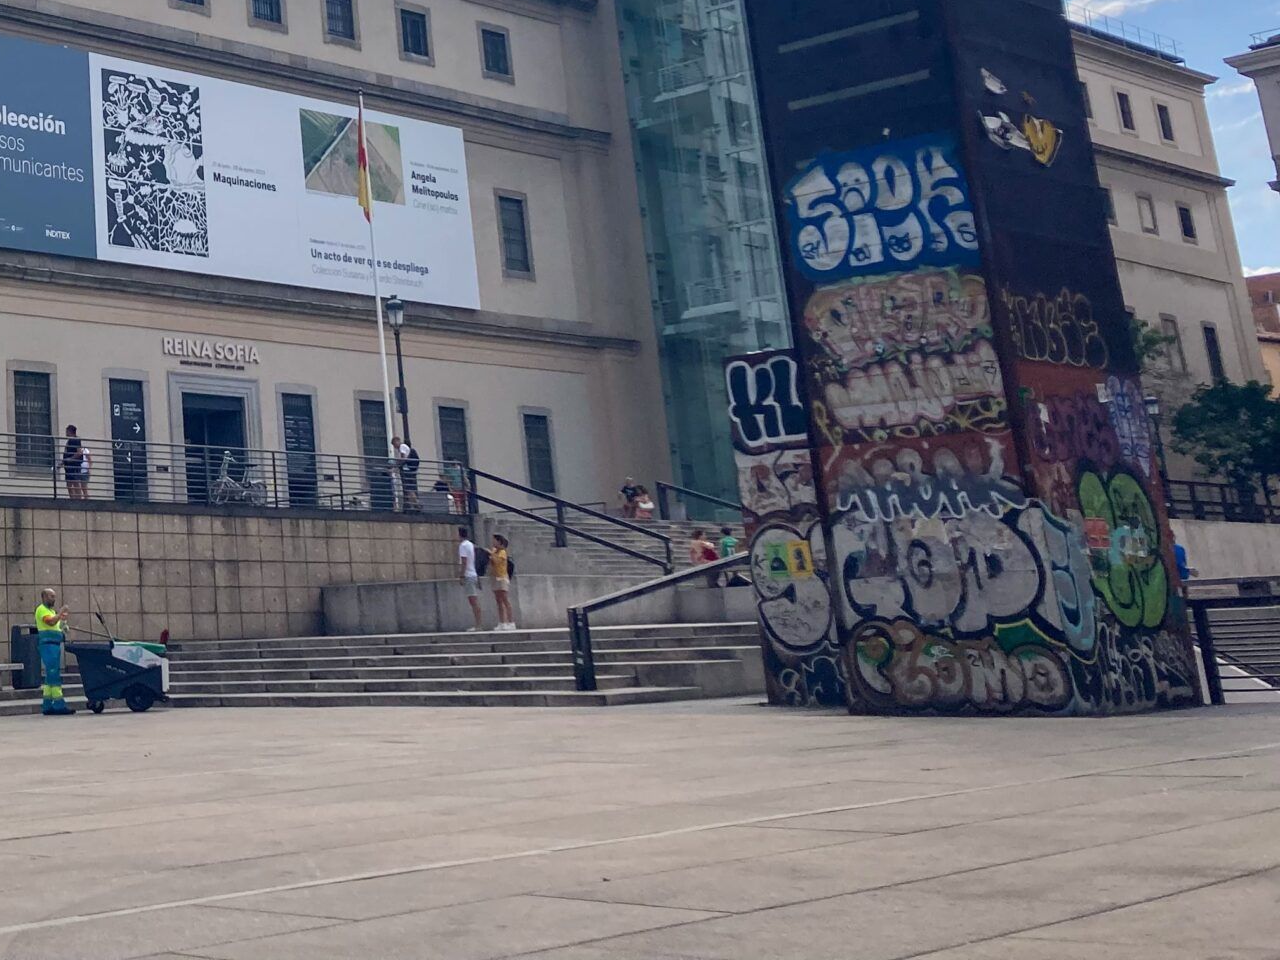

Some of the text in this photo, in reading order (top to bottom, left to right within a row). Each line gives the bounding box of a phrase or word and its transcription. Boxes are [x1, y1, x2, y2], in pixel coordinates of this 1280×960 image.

[213, 172, 277, 192] Maquinaciones
[411, 170, 437, 183] Angela
[411, 184, 459, 201] Melitopoulos
[45, 229, 71, 240] INDITEX
[310, 247, 323, 259] Un
[323, 251, 342, 262] acto
[342, 252, 353, 263] de
[354, 256, 365, 265] ver
[382, 259, 392, 269] se
[392, 259, 429, 276] despliega
[162, 337, 213, 359] REINA
